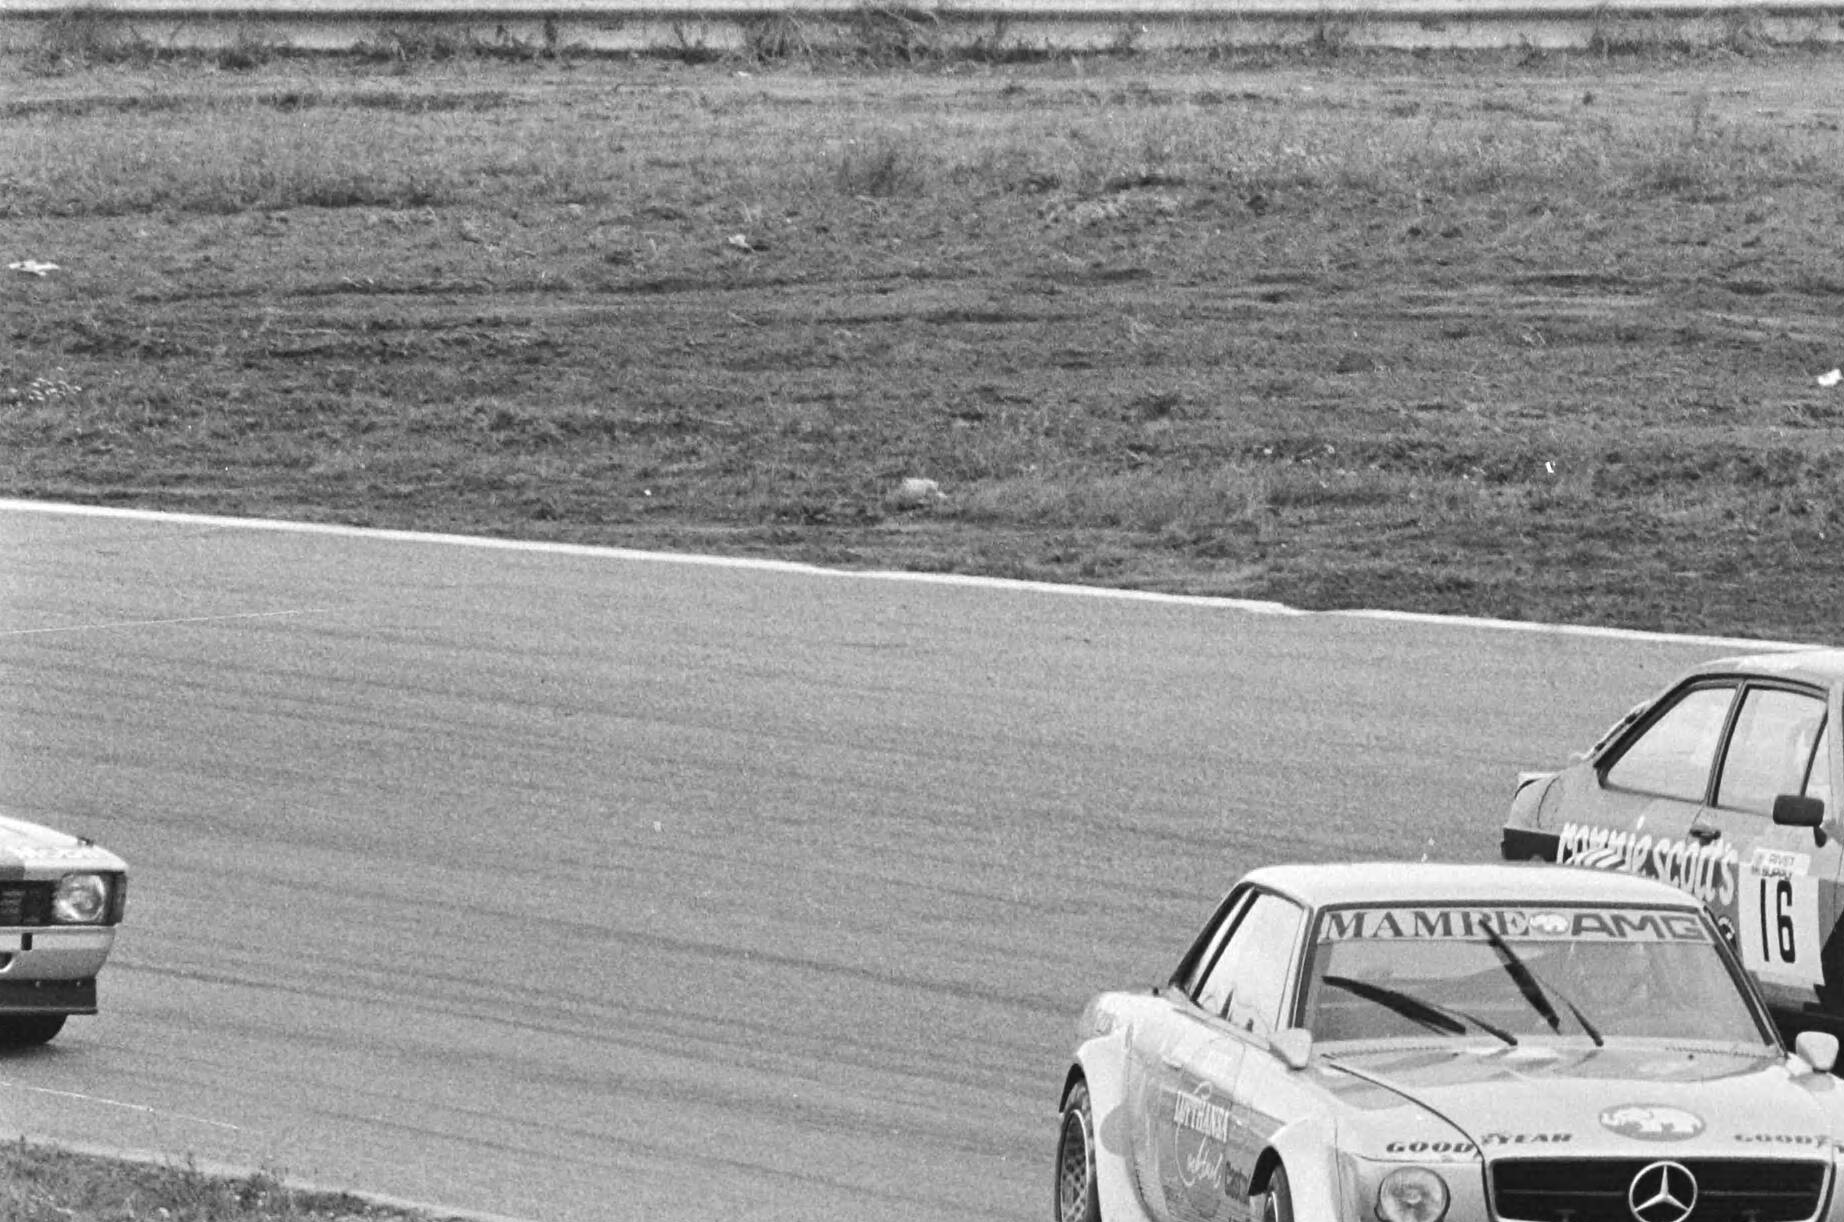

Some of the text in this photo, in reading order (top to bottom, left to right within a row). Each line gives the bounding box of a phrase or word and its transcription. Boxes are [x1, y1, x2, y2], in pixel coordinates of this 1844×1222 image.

[1324, 911, 1529, 938] MAMPE
[1570, 912, 1708, 941] AMG
[1759, 877, 1797, 964] 16
